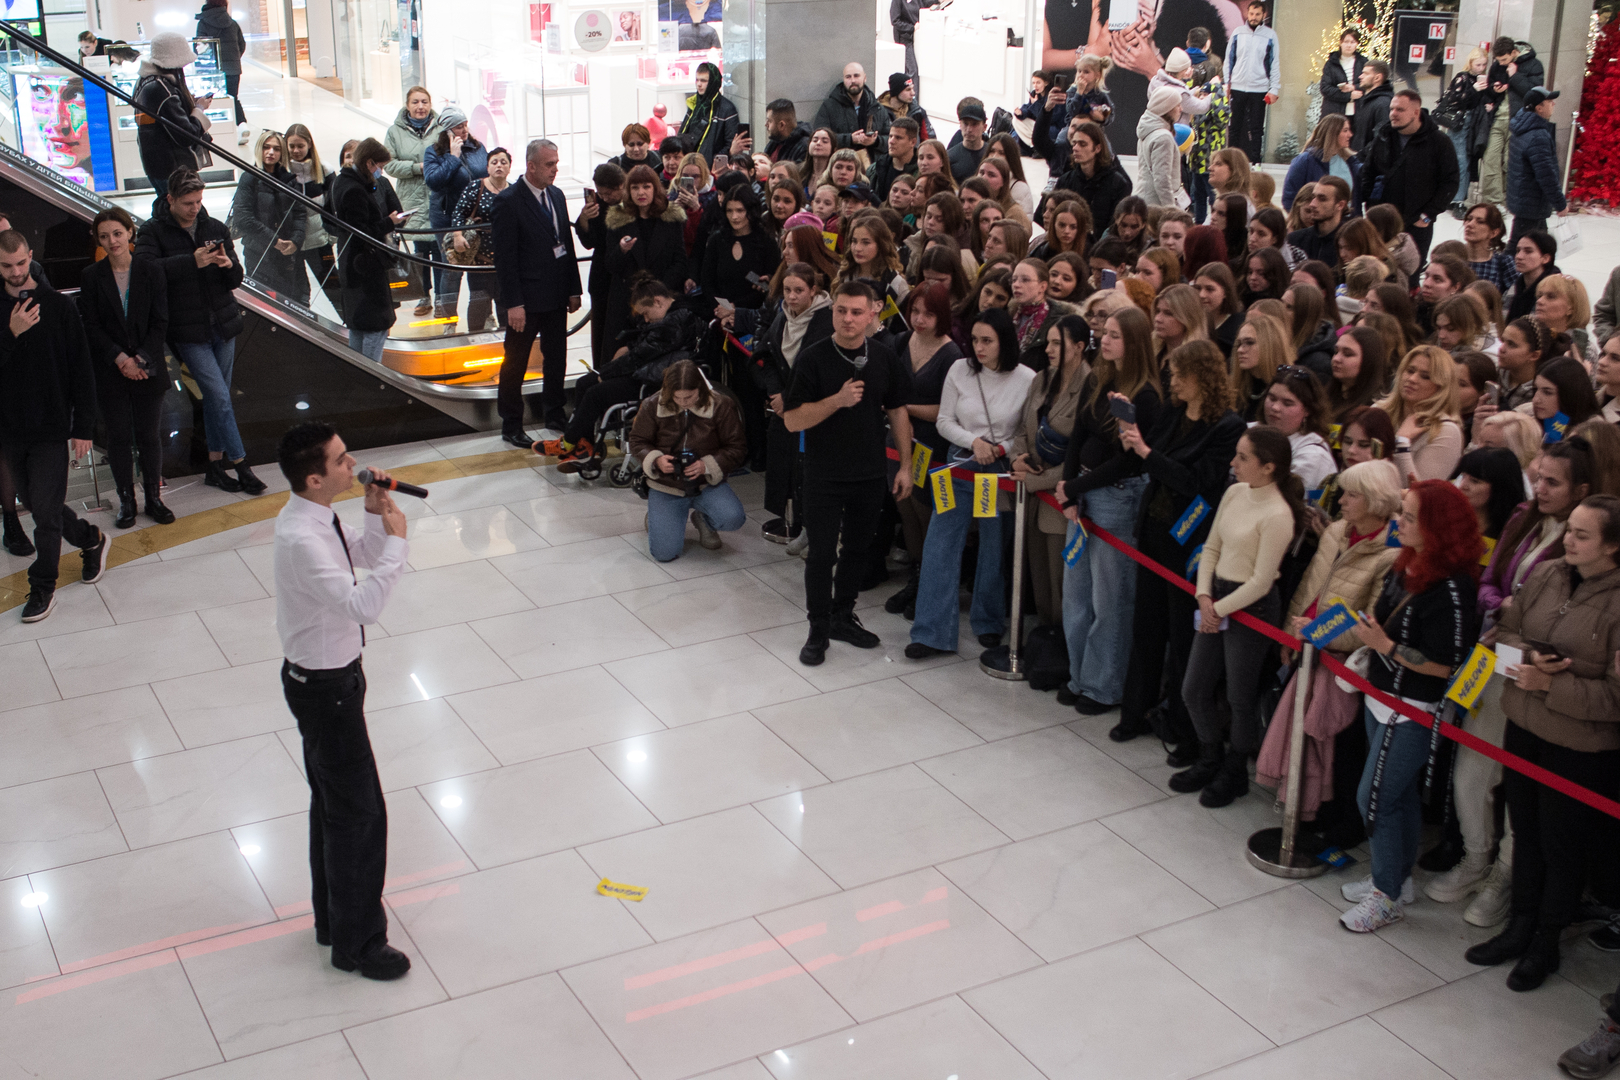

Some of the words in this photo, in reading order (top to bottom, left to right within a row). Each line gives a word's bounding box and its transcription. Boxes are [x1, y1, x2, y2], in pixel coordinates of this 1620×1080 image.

[1430, 25, 1444, 38] ПК
[28, 159, 36, 167] У
[35, 165, 63, 184] ДІТЕЙ
[64, 179, 99, 203] БІЛЬШЕ
[100, 198, 113, 209] НЕ
[1457, 652, 1488, 700] MÉLOVIN
